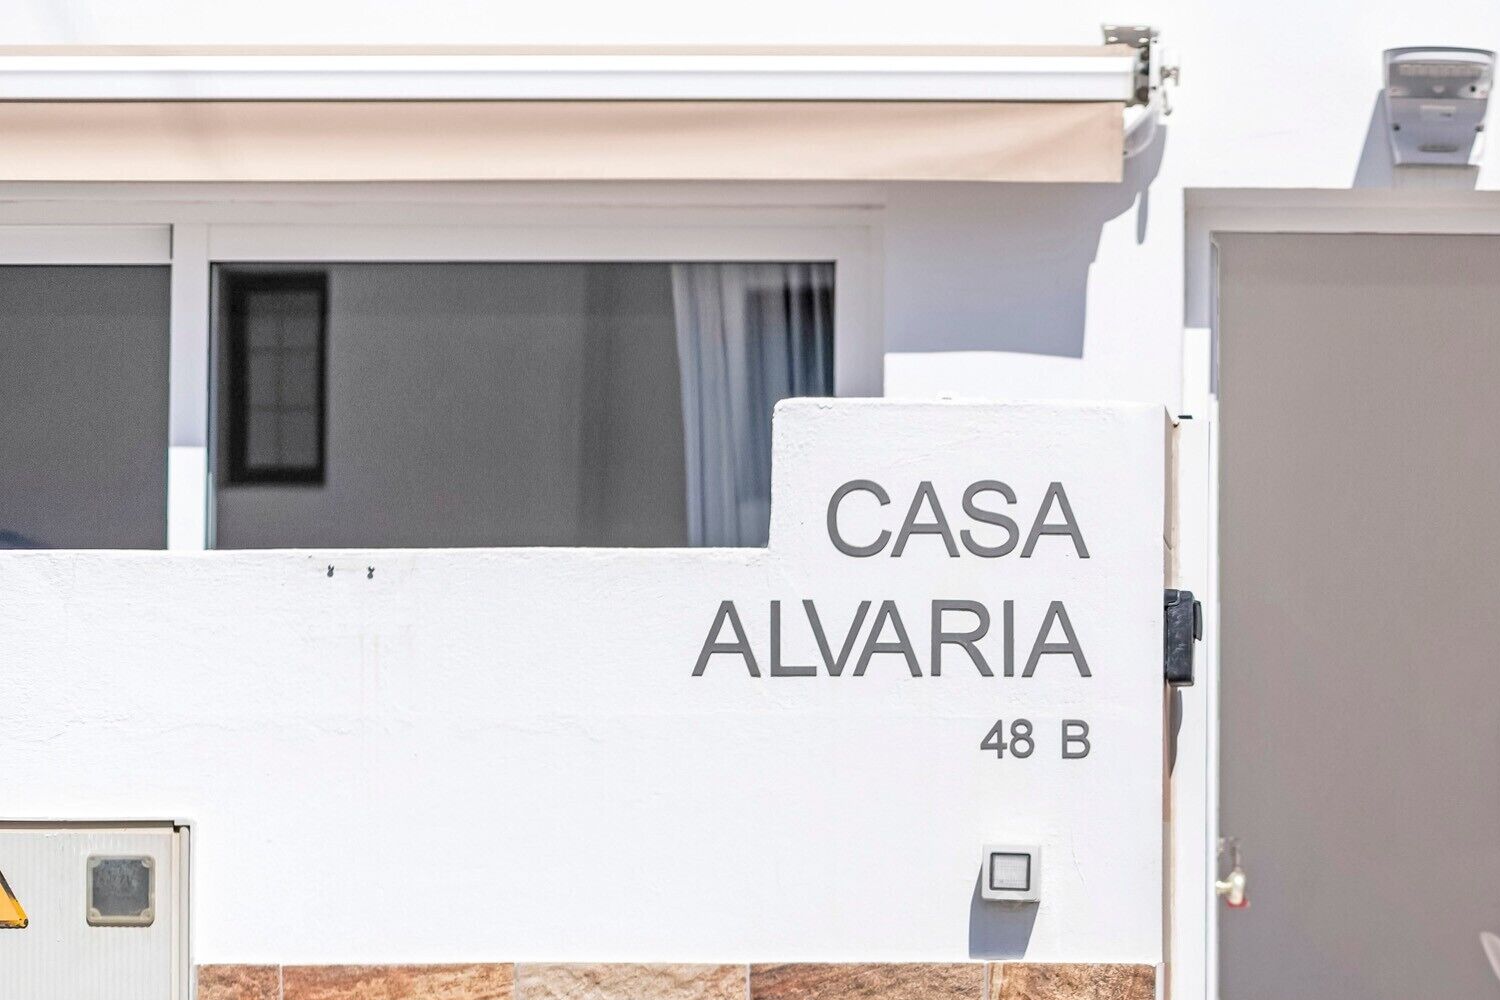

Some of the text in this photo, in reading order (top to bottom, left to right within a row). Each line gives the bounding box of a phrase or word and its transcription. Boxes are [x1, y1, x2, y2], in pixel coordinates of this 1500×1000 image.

[826, 479, 1091, 559] CASA
[691, 600, 1093, 678] ALVARIA
[979, 718, 1091, 759] 48 B
